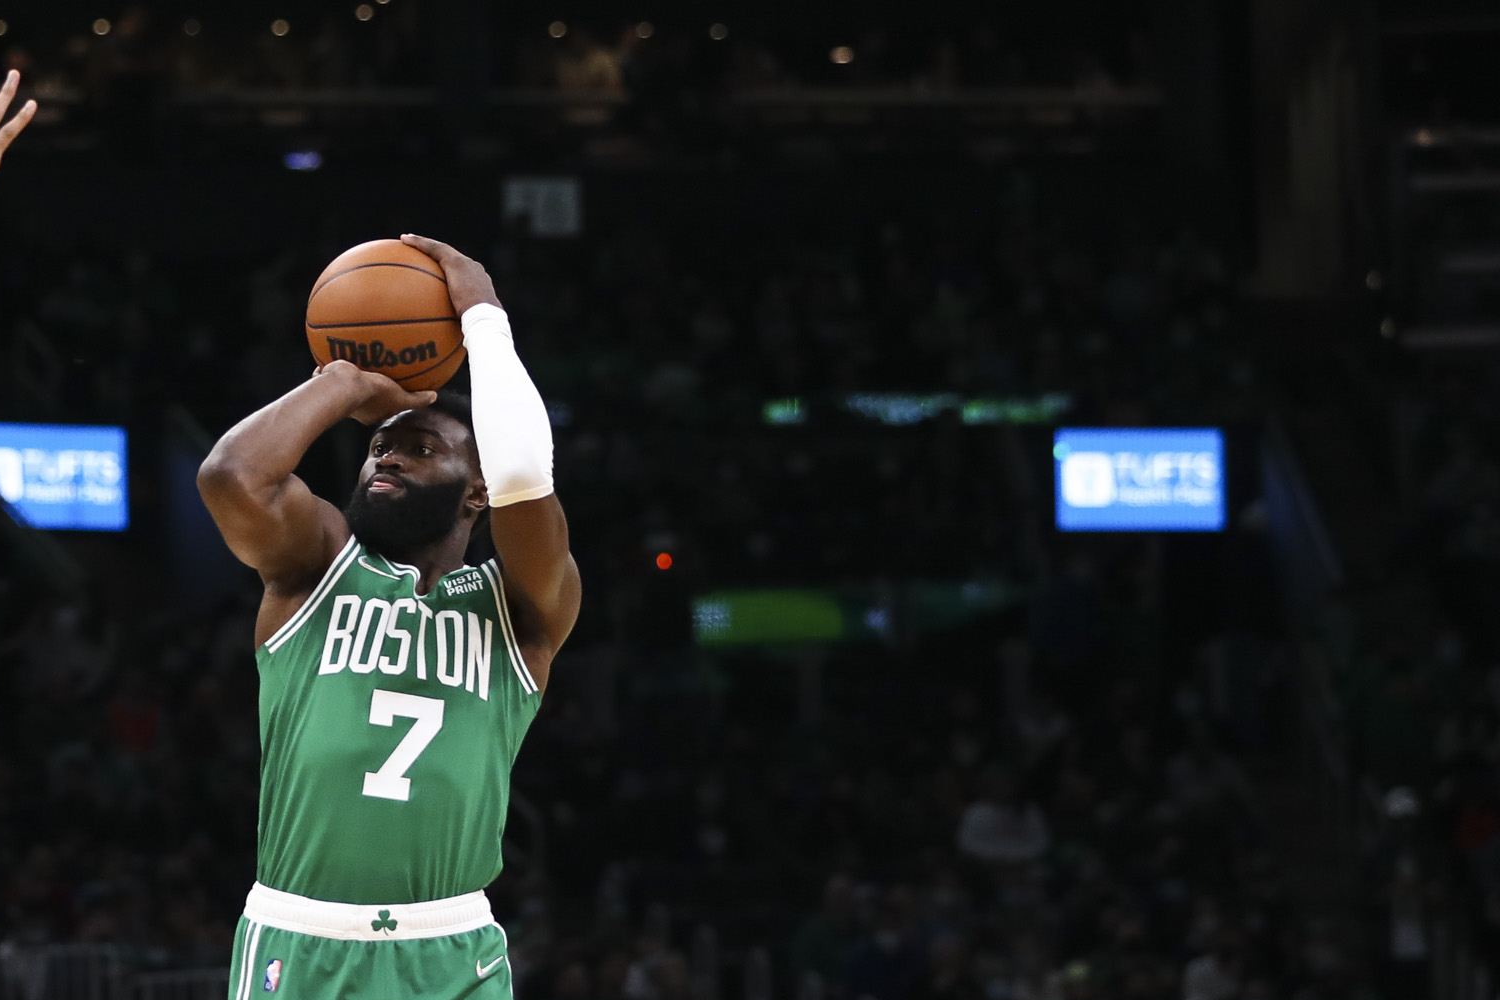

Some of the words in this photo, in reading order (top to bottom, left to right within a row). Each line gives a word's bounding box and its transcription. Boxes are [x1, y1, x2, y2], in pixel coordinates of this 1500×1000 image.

[326, 335, 439, 369] Wilson
[443, 570, 483, 589] VISTA
[446, 579, 485, 597] PRINT
[317, 594, 494, 702] BOSTON
[361, 688, 446, 802] 7
